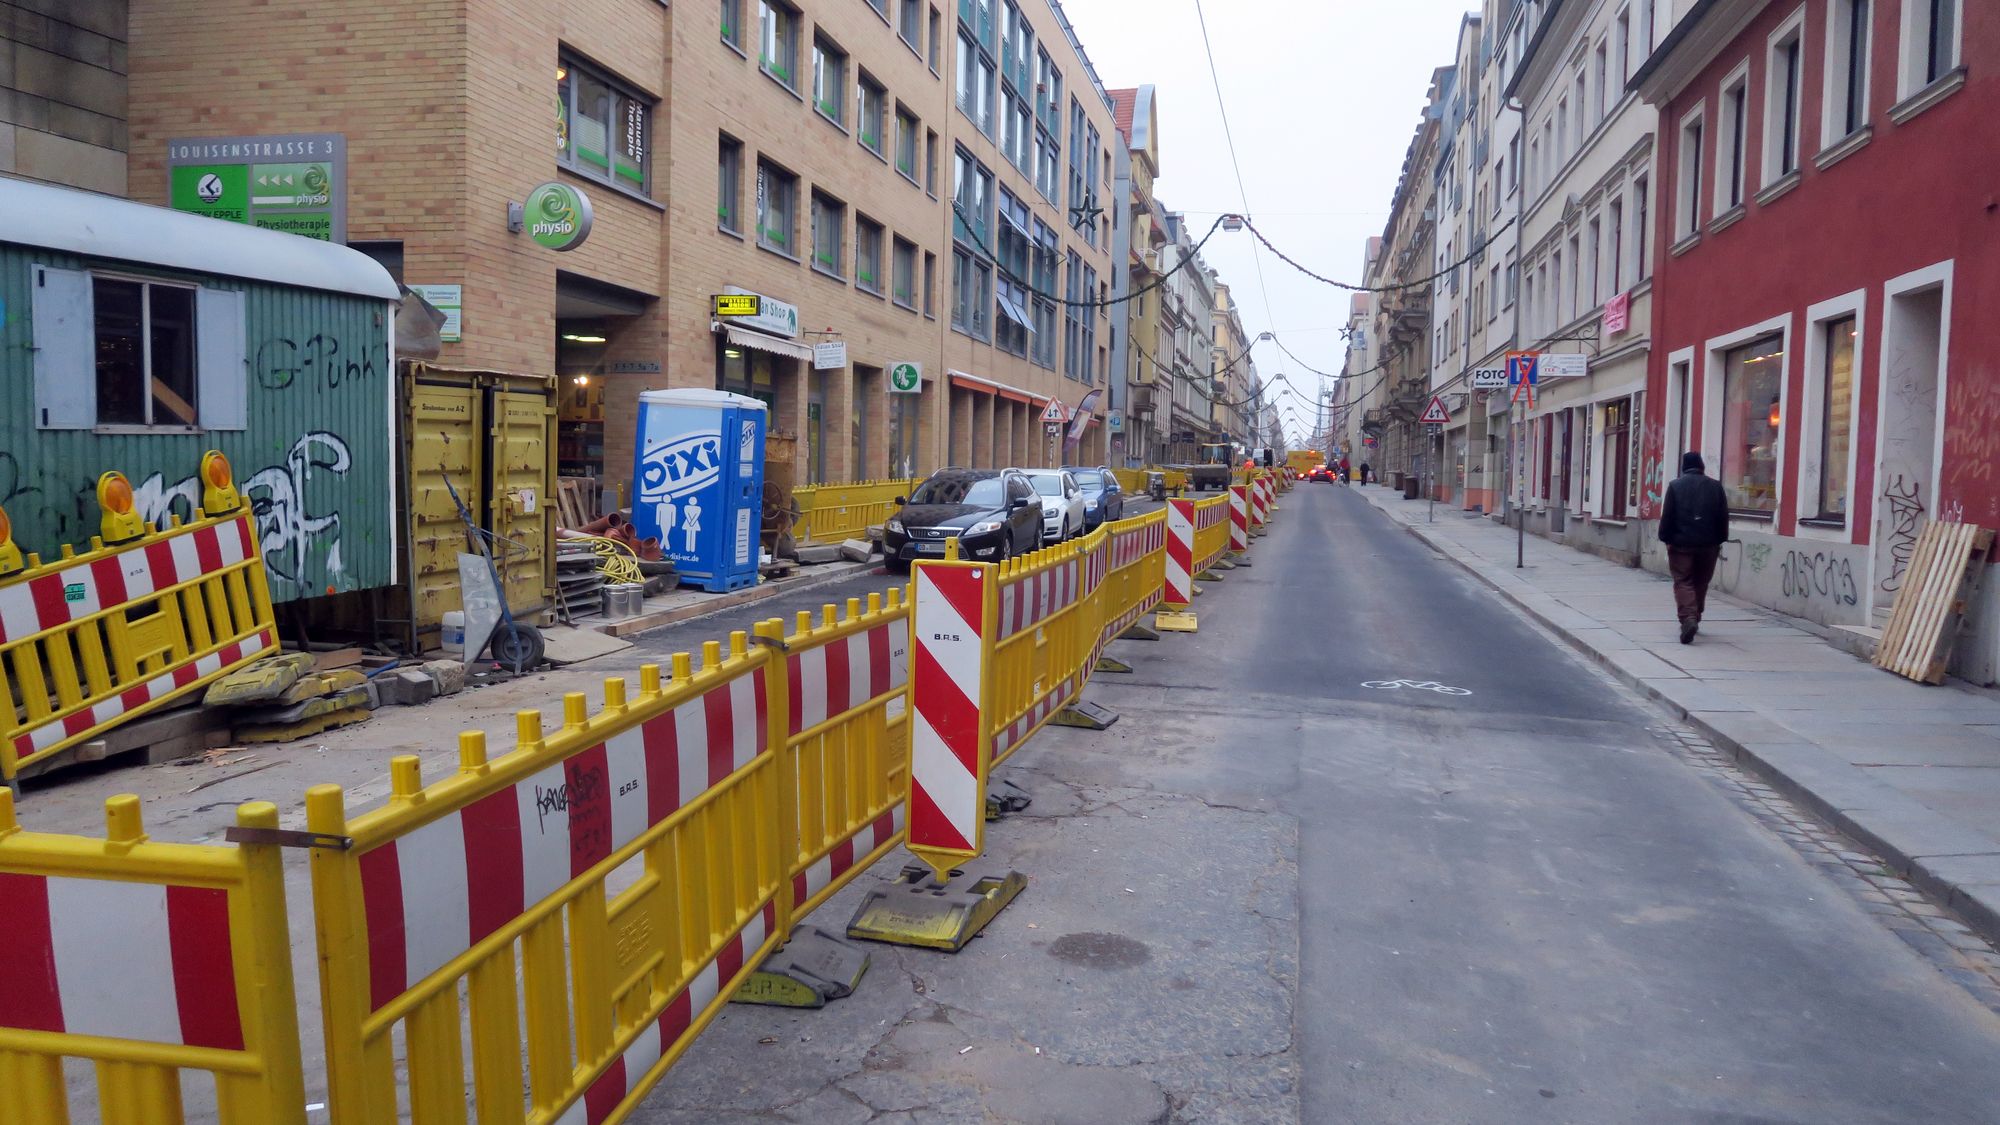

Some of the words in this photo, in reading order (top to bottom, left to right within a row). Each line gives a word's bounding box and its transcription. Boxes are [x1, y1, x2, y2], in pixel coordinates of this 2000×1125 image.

[635, 101, 644, 163] Manuelle
[171, 141, 314, 159] LOUISENSTRASSE
[325, 140, 333, 154] 3
[296, 195, 327, 206] physio
[213, 210, 242, 219] EPPLE
[256, 219, 330, 231] Physiotherapie
[532, 221, 573, 236] physio
[770, 302, 786, 319] Shop
[1476, 370, 1506, 380] FOTO
[455, 404, 465, 413] A-Z
